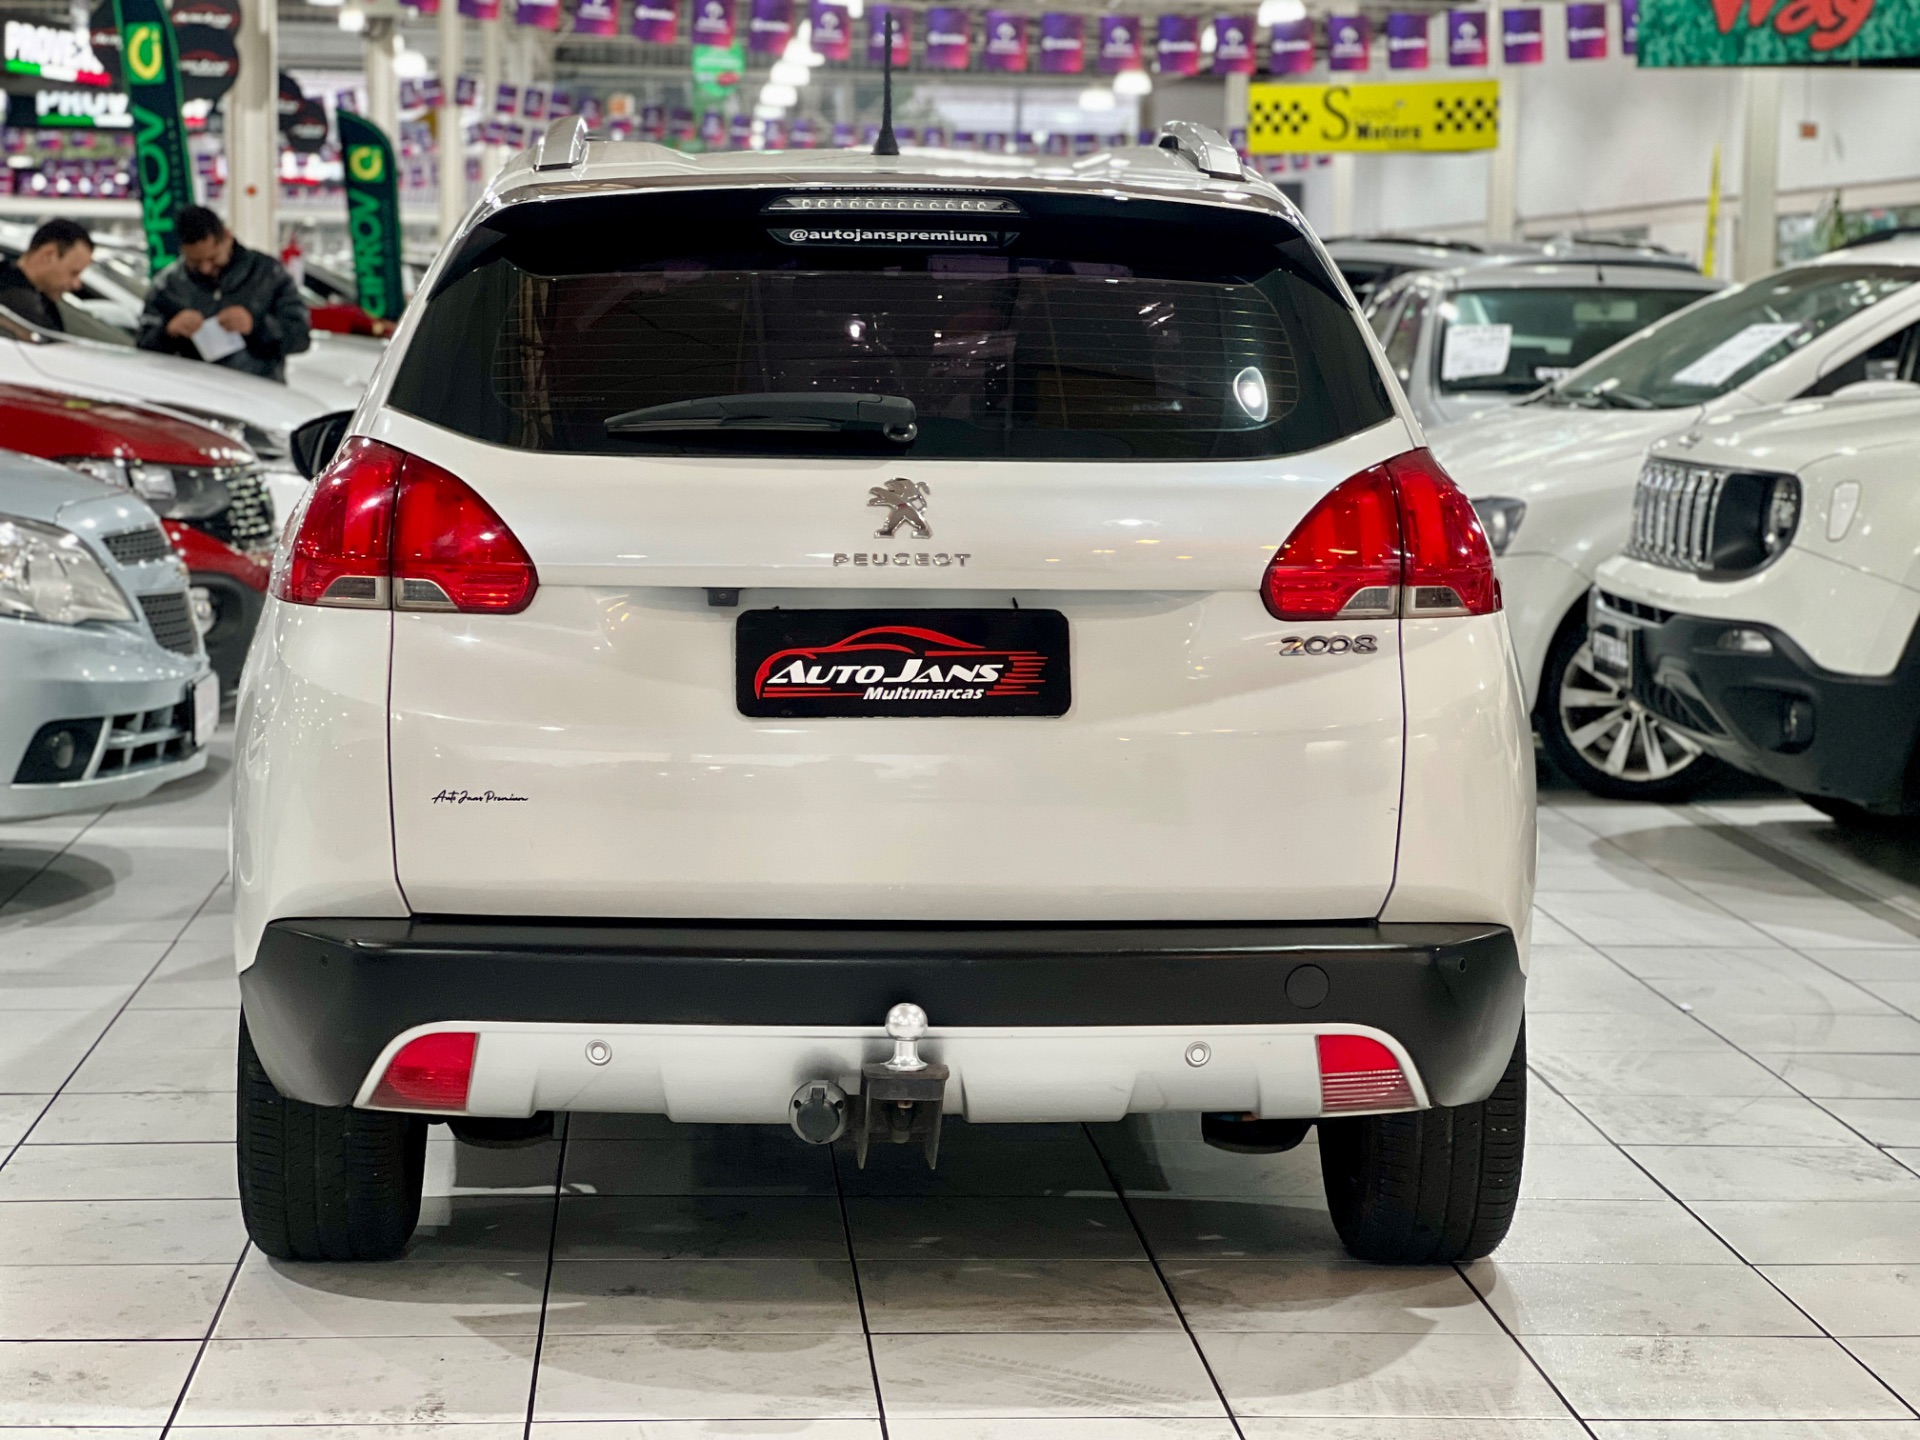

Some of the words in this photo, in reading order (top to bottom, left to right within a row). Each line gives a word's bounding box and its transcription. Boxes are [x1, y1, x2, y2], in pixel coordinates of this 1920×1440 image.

[789, 228, 988, 242] @autojanspremium
[833, 552, 972, 567] PEUGEOT
[1279, 634, 1378, 656] 2008
[862, 686, 985, 700] Multimarcas
[431, 789, 459, 804] Auto
[484, 790, 529, 804] Premium
